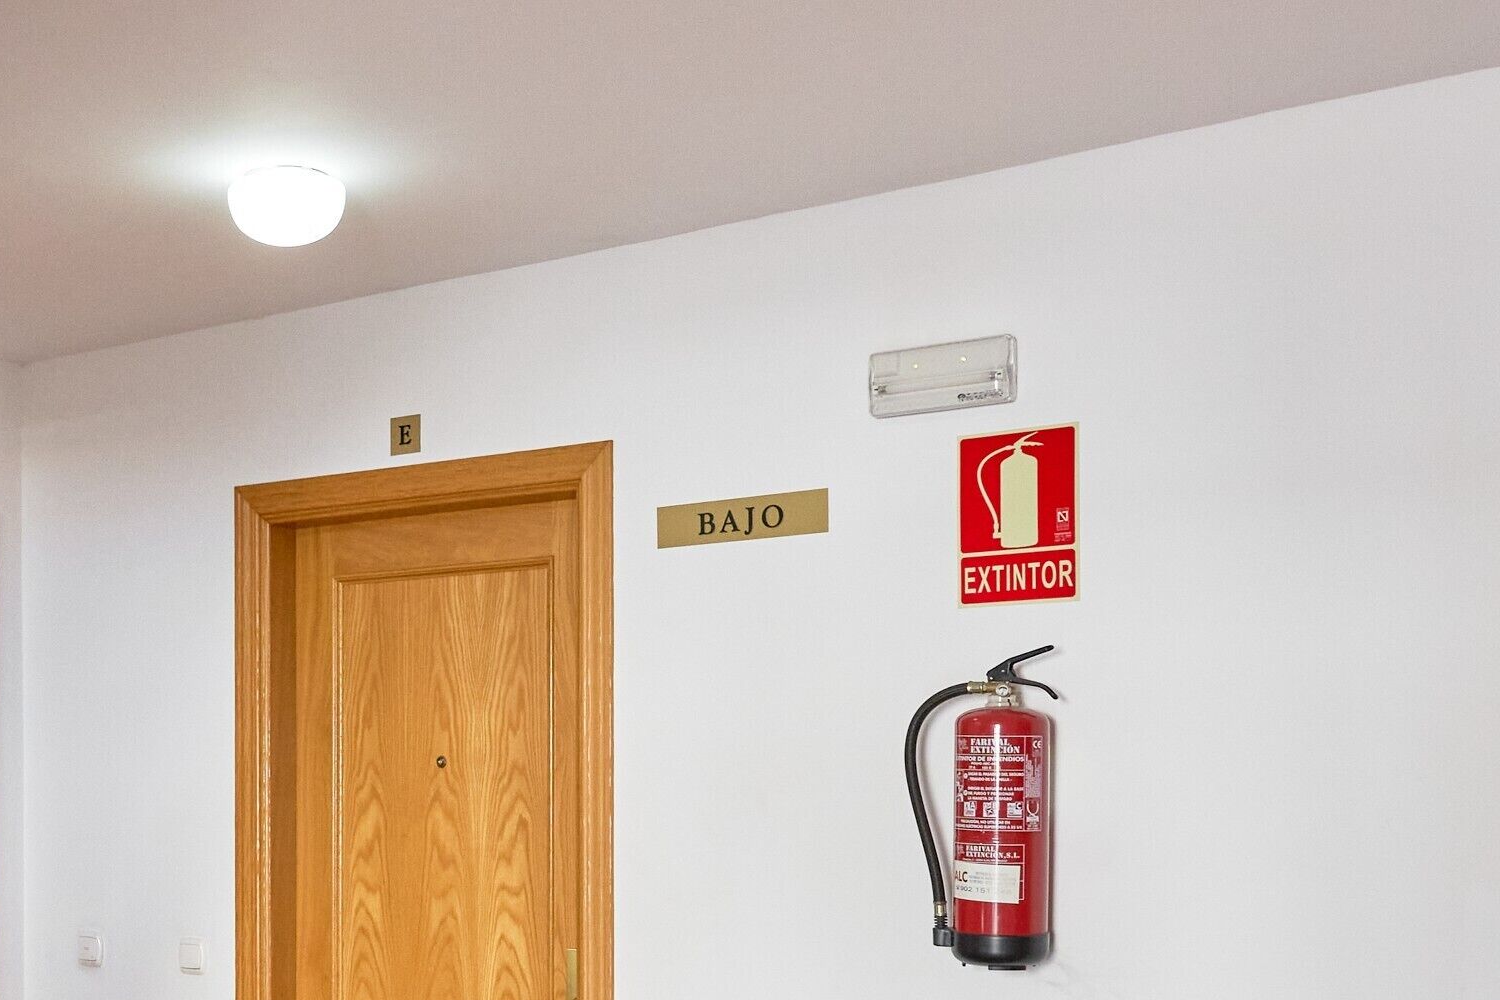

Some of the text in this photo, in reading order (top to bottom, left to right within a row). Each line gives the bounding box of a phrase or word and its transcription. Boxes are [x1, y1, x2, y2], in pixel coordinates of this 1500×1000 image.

[398, 424, 412, 445] E
[697, 504, 784, 535] BAJO
[964, 559, 1074, 594] EXTINTOR
